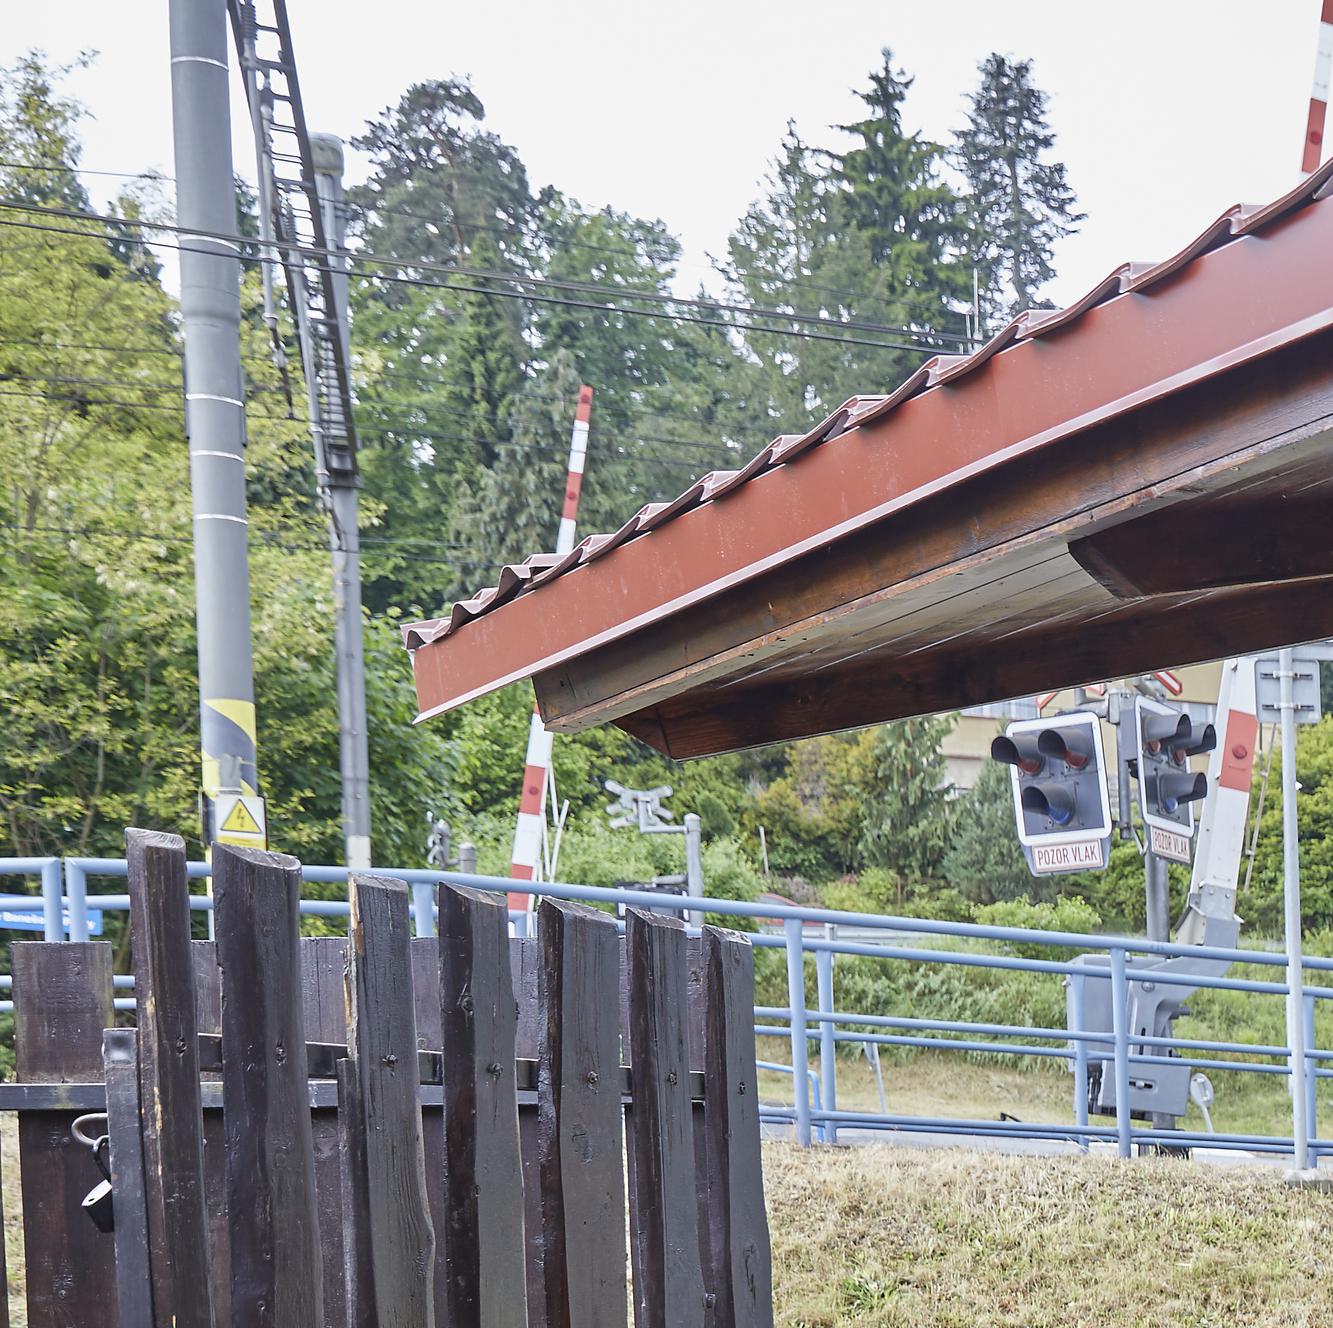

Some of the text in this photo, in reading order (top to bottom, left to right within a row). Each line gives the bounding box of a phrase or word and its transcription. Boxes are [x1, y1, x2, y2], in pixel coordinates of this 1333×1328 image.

[1037, 843, 1098, 867] POZOR VLAK
[1153, 831, 1189, 855] POZOR VLAK
